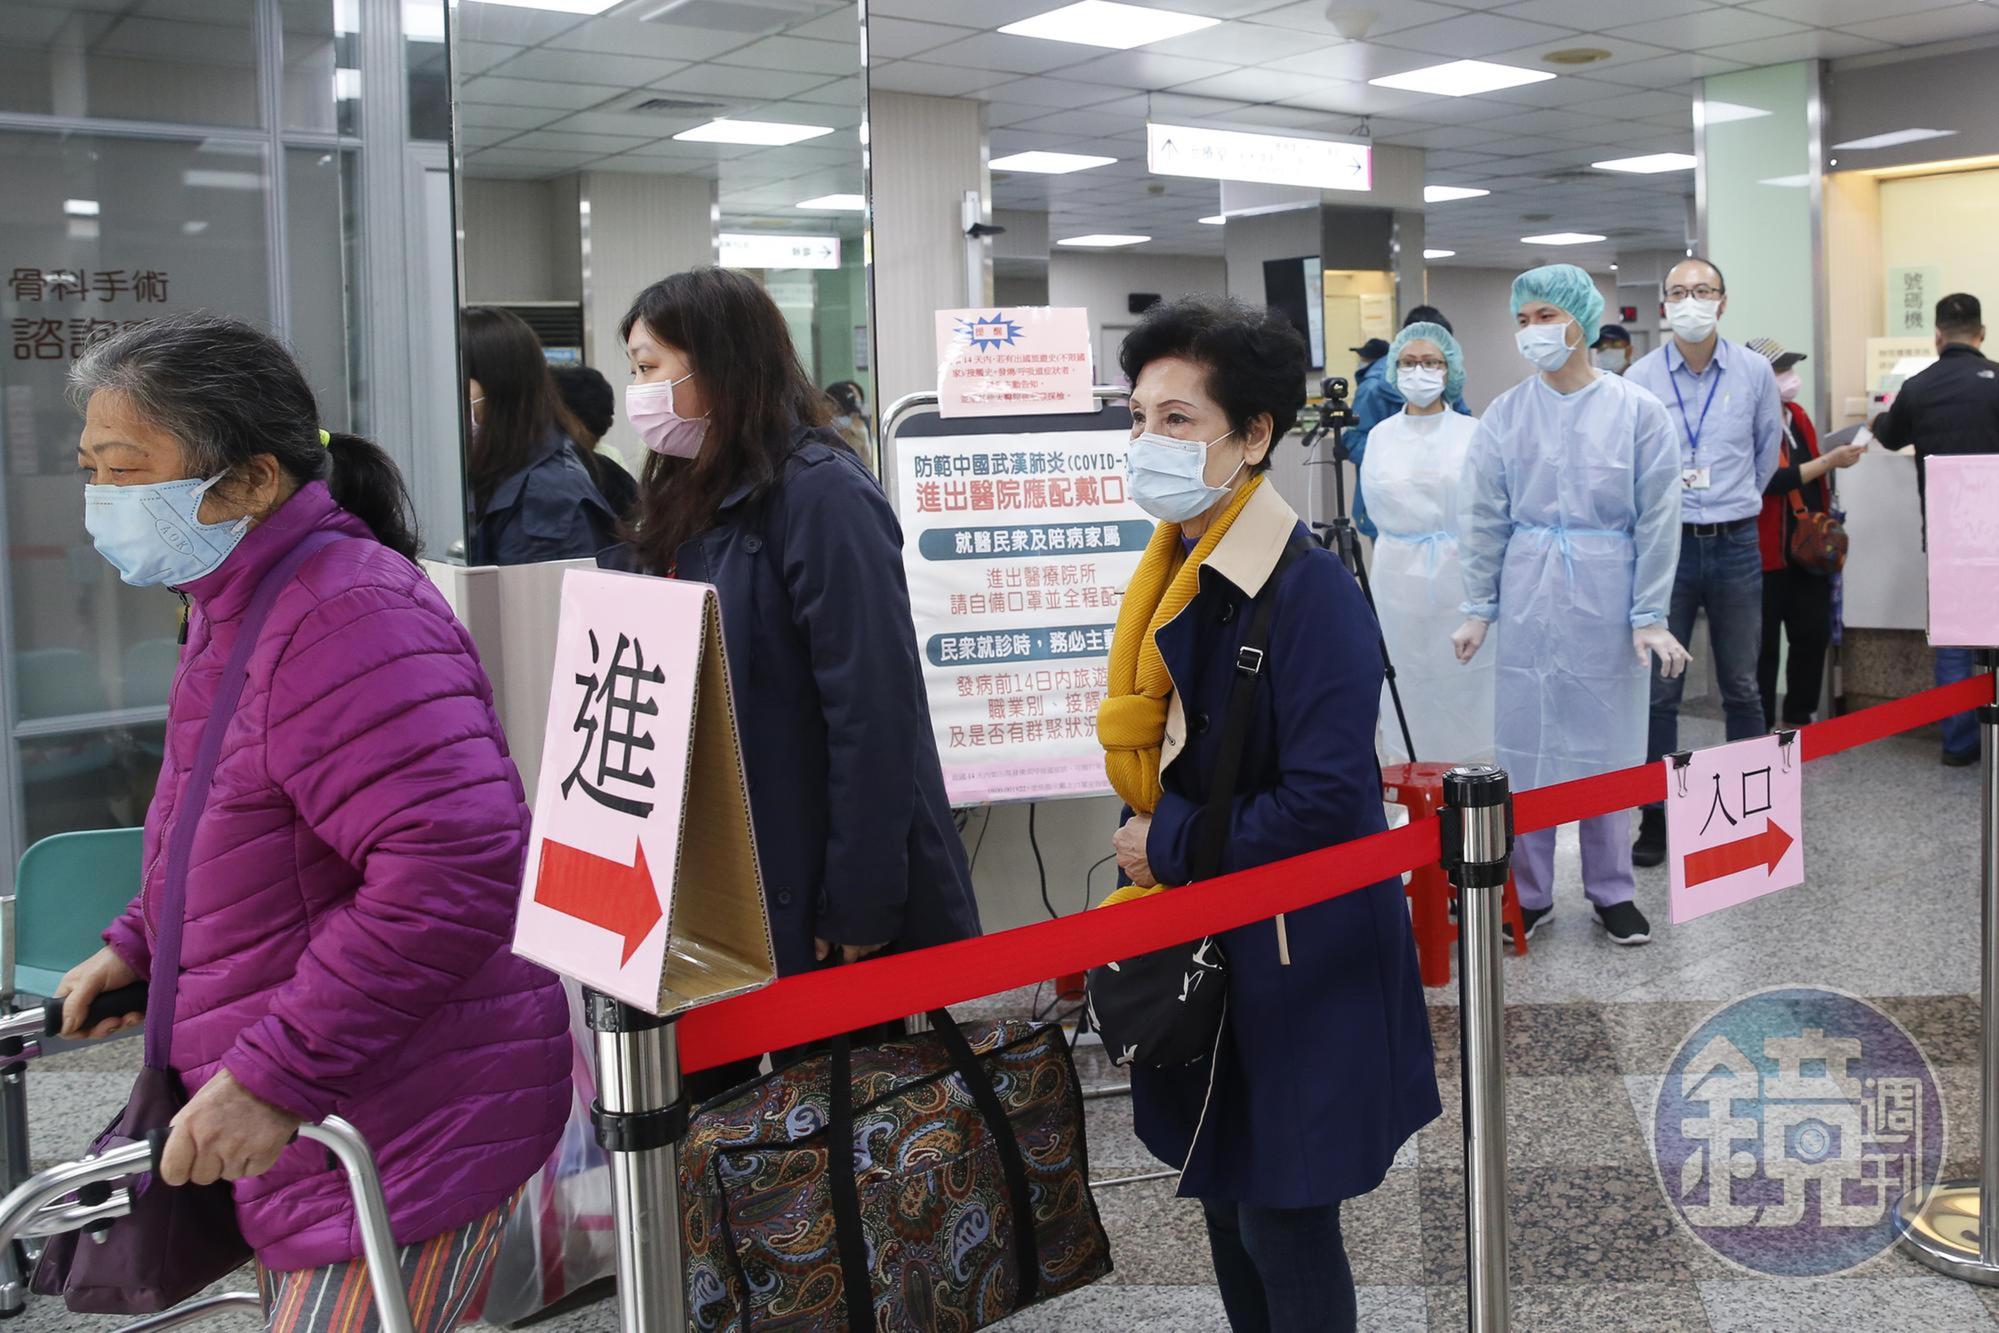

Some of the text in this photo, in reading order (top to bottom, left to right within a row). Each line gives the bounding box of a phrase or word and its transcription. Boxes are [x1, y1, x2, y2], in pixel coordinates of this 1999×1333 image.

[9, 268, 169, 302] 骨科手術
[11, 317, 152, 360] 諮詢
[916, 475, 1132, 513] 進出醫院應配戴口
[160, 526, 189, 550] AOK
[986, 563, 1096, 589] 進出醫療院所
[988, 691, 1108, 720] 職業別、接觸
[560, 629, 666, 819] 進
[1700, 766, 1772, 836] 入口
